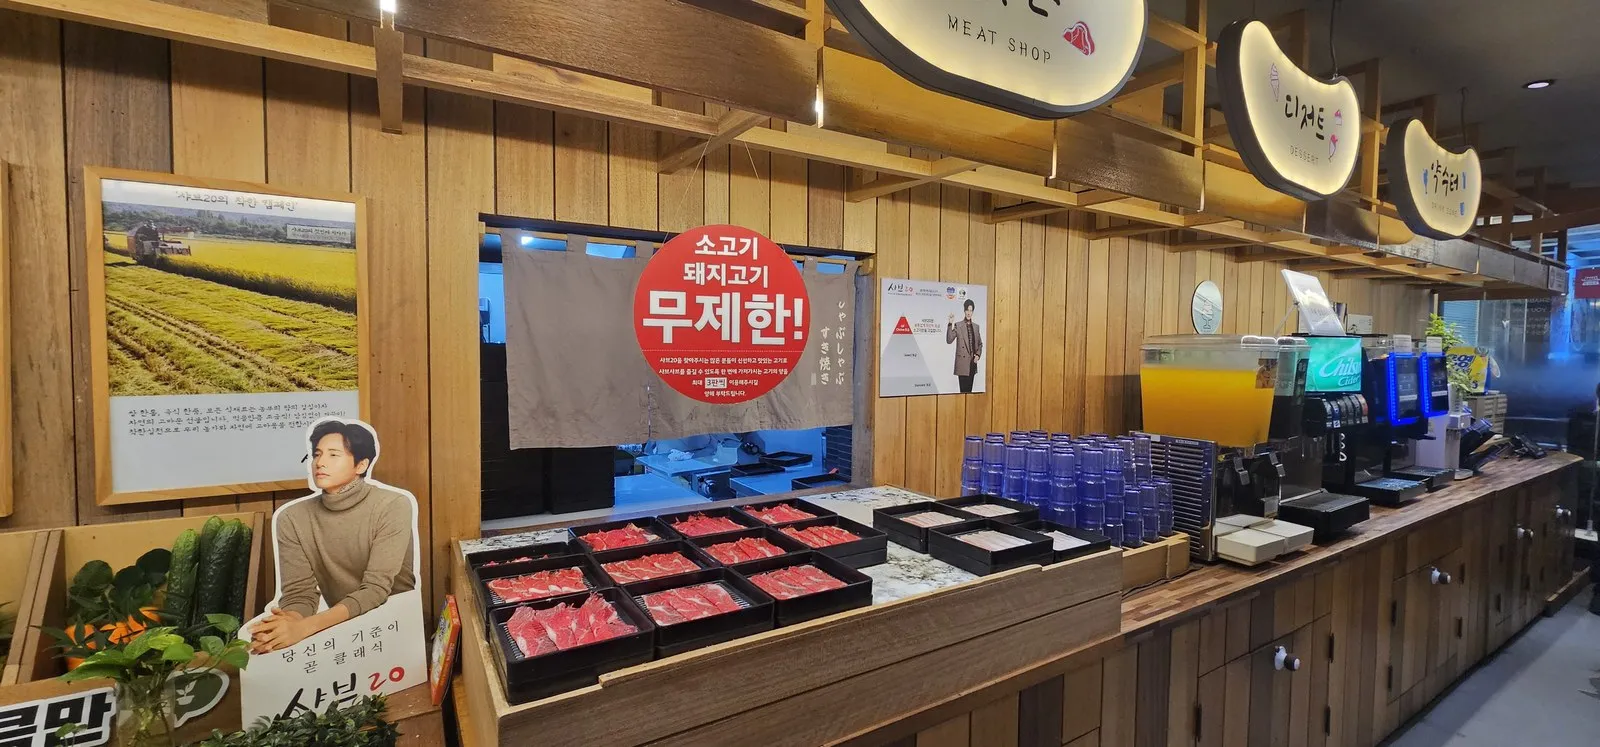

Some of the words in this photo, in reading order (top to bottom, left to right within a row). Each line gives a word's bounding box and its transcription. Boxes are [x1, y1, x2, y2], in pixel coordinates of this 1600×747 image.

[947, 14, 997, 45] MEAT
[1008, 37, 1051, 64] SHOP
[1284, 94, 1325, 141] 디저트
[1290, 145, 1319, 165] DESSERT
[1431, 160, 1459, 197] 약수터
[235, 197, 257, 209] 착한
[694, 234, 759, 260] 소고기
[683, 262, 769, 288] 돼지고기
[642, 290, 804, 345] 무제한!
[819, 326, 831, 385] すき焼き
[835, 301, 847, 385] しゃぶしゃぶ
[706, 378, 726, 387] 3판씩
[1338, 375, 1360, 387] Cider
[129, 418, 154, 426] 자연의
[158, 417, 183, 425] 고마운
[186, 415, 229, 424] 선물입니다.
[164, 407, 180, 415] 곡식
[258, 404, 280, 412] 농부의
[230, 423, 252, 431] 자연에
[256, 421, 285, 429] 고마움을
[281, 637, 336, 664] 당신의
[351, 620, 400, 644] 기준이
[303, 660, 318, 674] 곧
[333, 640, 383, 665] 클래식
